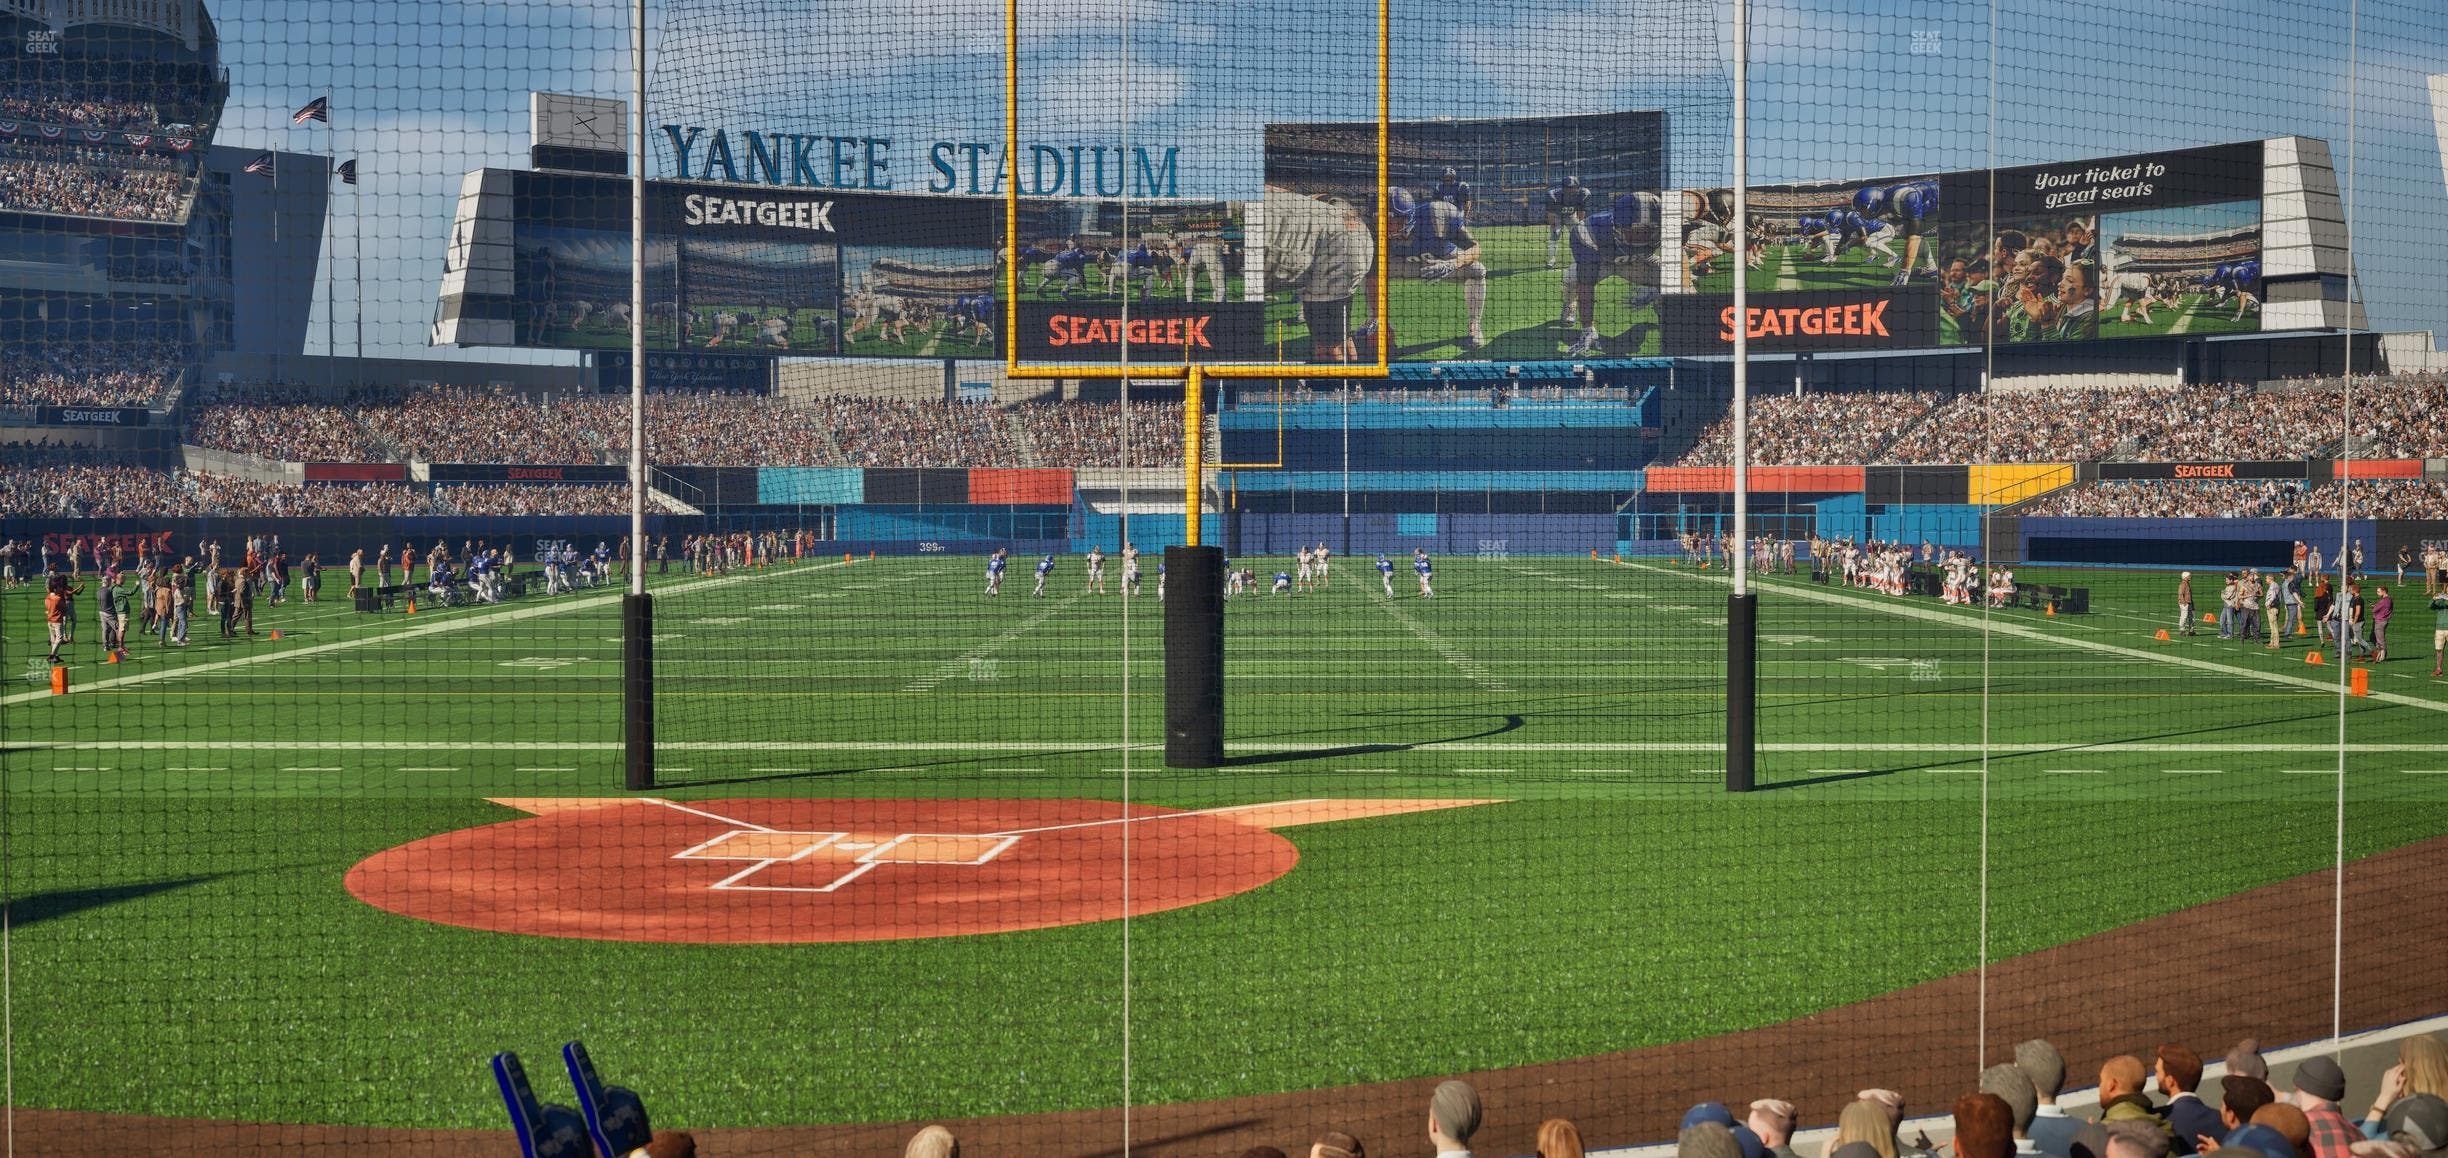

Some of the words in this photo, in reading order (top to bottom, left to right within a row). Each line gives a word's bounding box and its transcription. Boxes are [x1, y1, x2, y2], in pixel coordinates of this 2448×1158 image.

[660, 124, 891, 190] YANKEE
[929, 142, 1181, 197] STADIUM
[2034, 172, 2081, 190] Your
[2085, 163, 2142, 184] ticket
[2145, 162, 2165, 177] to
[2045, 186, 2098, 209] great
[2101, 181, 2154, 200] seats
[684, 193, 836, 232] SEATGEEK
[1049, 314, 1212, 348] SEATGEEK
[1720, 300, 1890, 342] SEATGEEK
[62, 409, 120, 424] SEATGEEK
[507, 467, 564, 480] SEATGEEK
[2175, 464, 2234, 478] SEATGEEK
